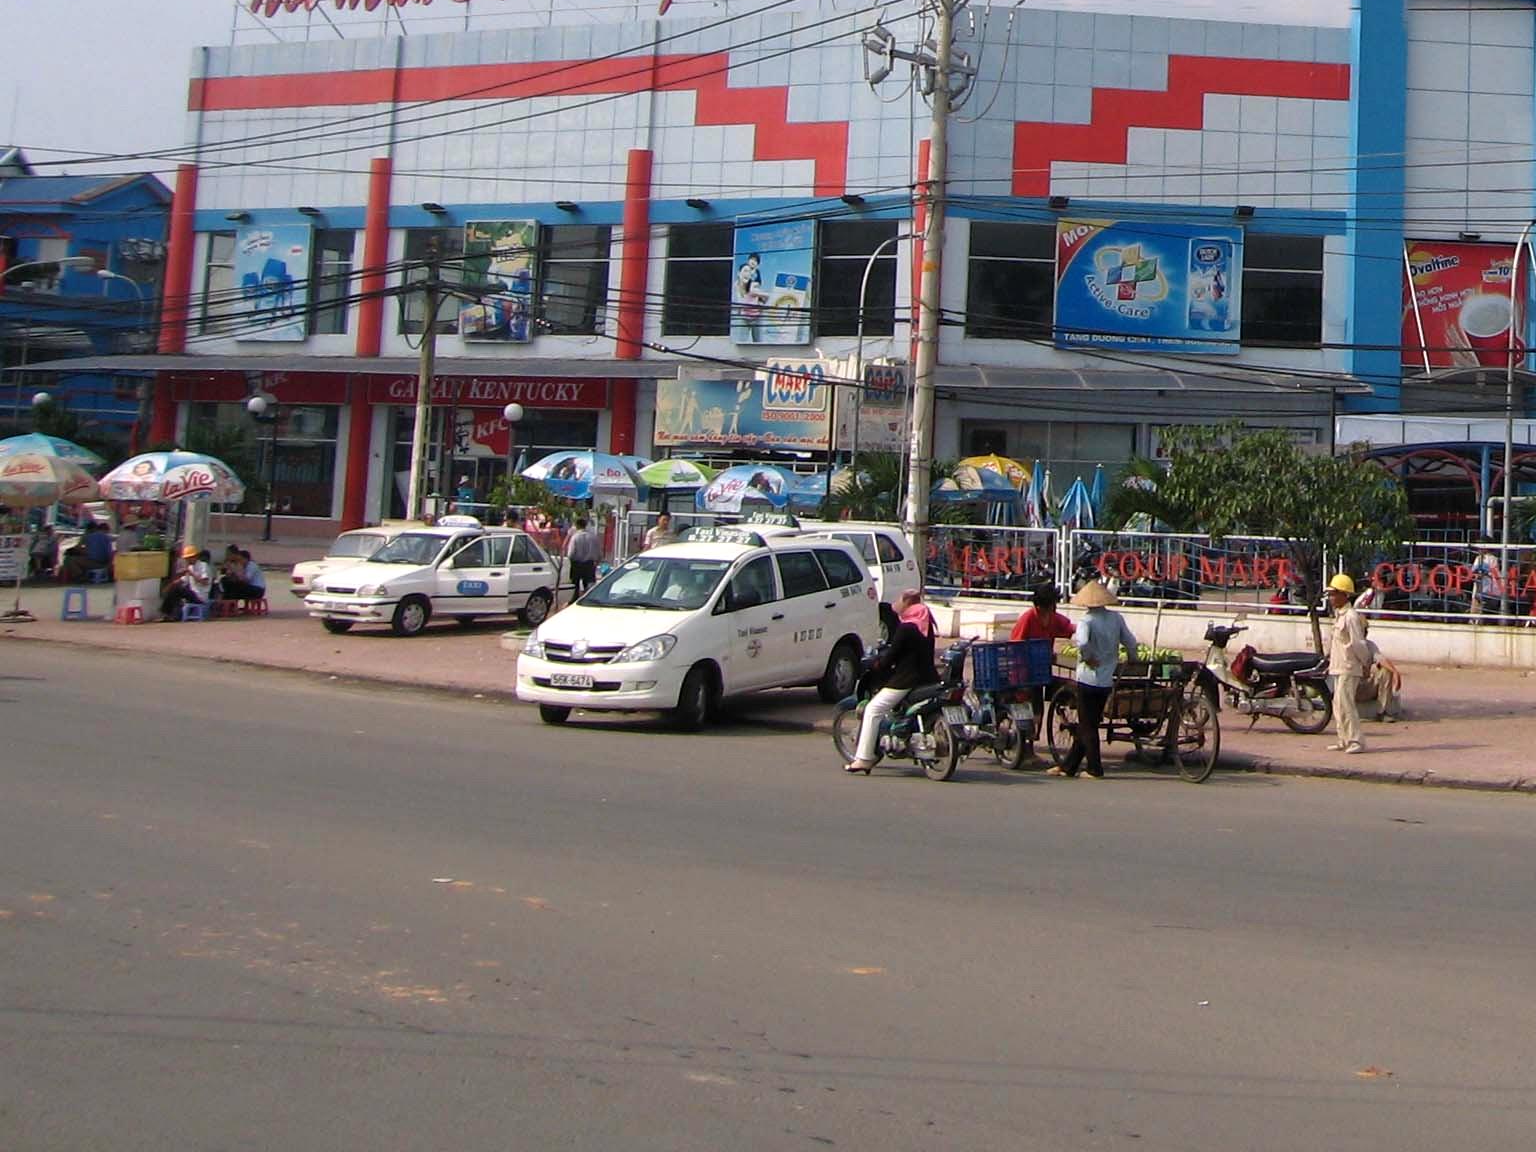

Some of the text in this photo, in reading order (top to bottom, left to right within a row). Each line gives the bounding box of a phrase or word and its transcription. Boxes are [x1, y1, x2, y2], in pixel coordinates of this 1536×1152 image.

[470, 381, 584, 401] KENTUCKY
[695, 527, 713, 535] Taxi
[1199, 554, 1292, 589] MART
